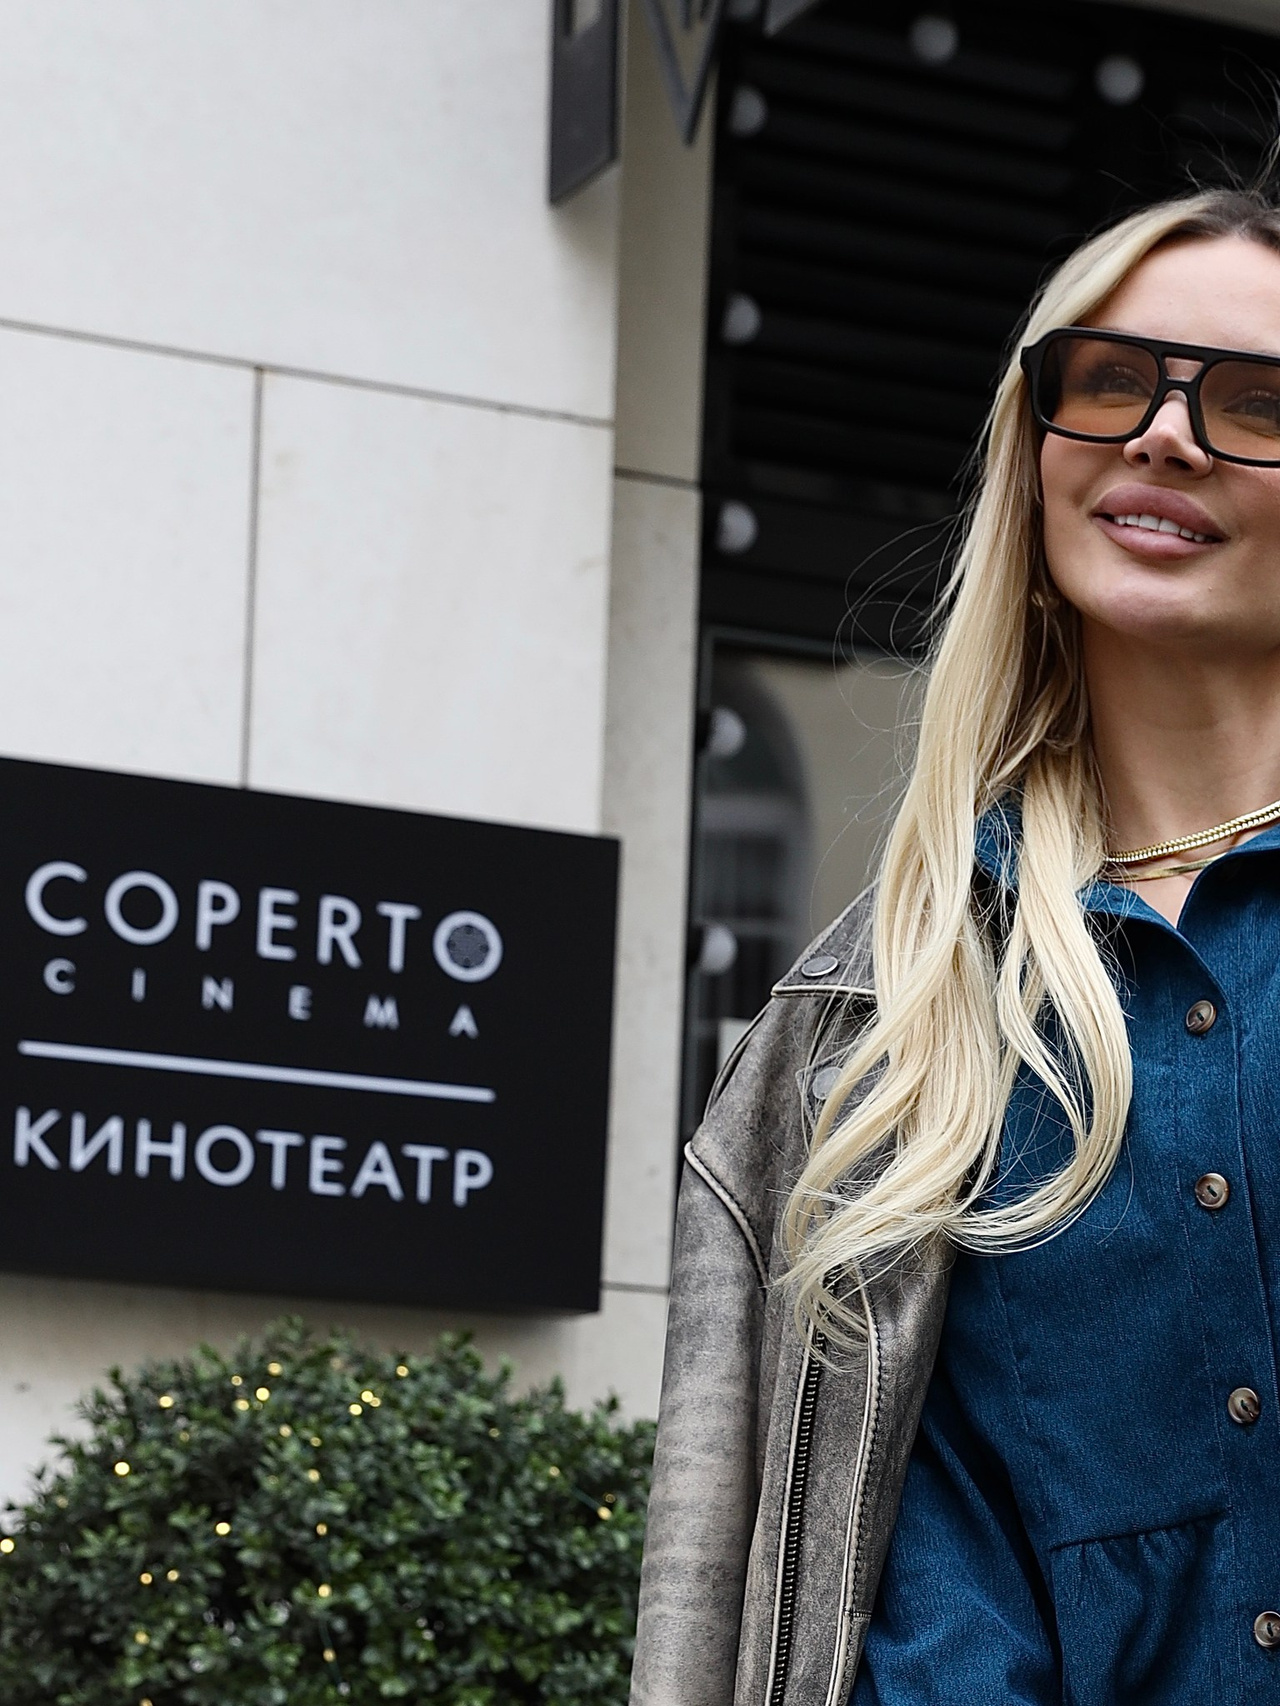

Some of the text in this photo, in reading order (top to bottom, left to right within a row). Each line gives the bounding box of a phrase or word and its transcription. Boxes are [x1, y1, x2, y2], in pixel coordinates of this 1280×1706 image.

[25, 861, 503, 983] COPERTO
[43, 958, 479, 1038] CINEMA
[13, 1106, 494, 1206] КИНОТЕАТР
